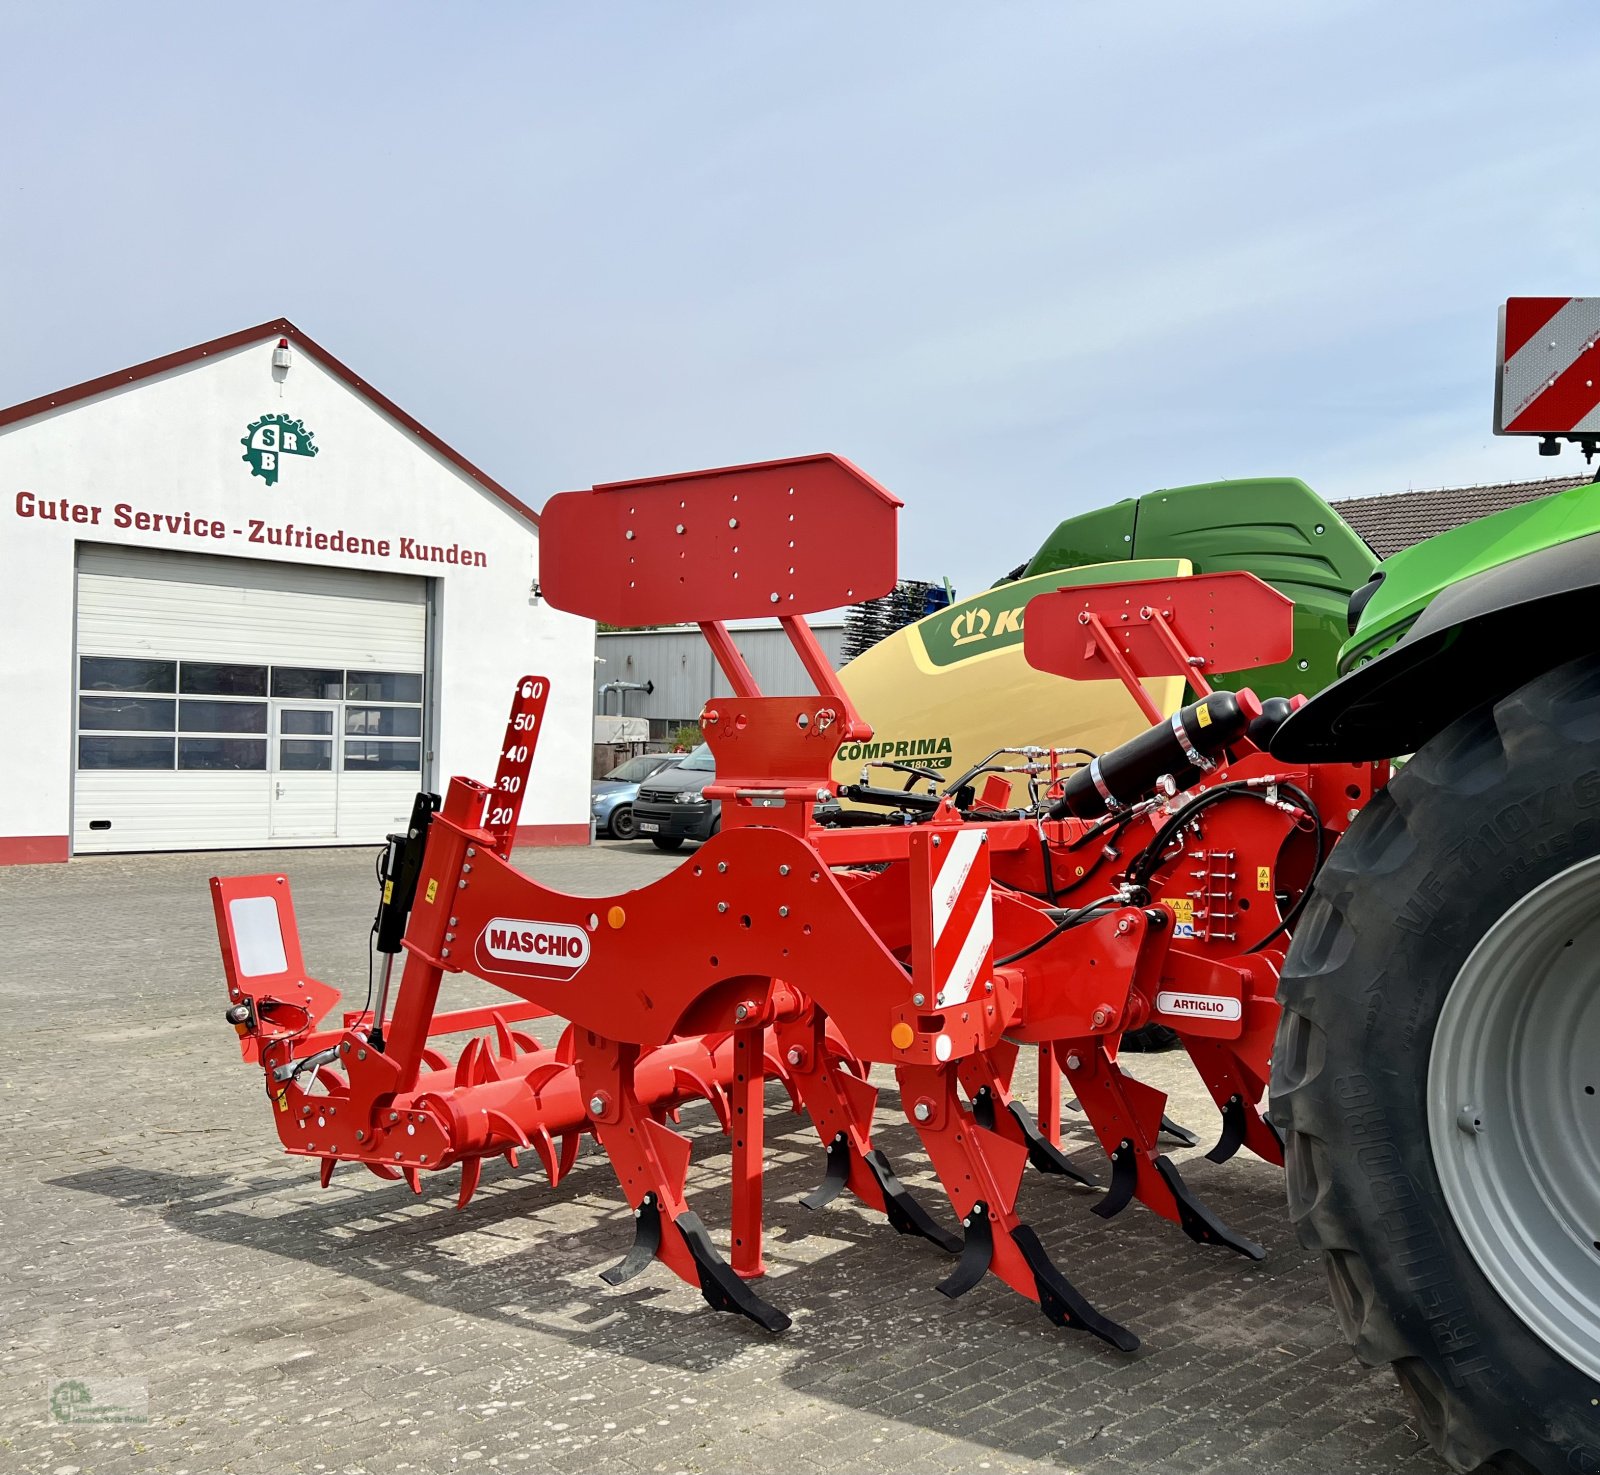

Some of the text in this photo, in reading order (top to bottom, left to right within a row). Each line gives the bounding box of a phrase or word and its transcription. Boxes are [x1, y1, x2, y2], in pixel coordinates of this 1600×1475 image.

[15, 491, 102, 525] Guter
[113, 503, 225, 540] Service
[248, 519, 390, 557] Zufriedene
[399, 537, 487, 568] Kunden
[520, 680, 543, 700] 60
[513, 713, 536, 731] 50
[505, 745, 528, 763] 40
[836, 737, 952, 761] COMPRIMA
[930, 759, 946, 768] XC
[498, 776, 521, 794] 30
[490, 807, 513, 825] 20
[489, 928, 584, 959] MASCHIO
[1173, 998, 1224, 1013] ARTIGLIO
